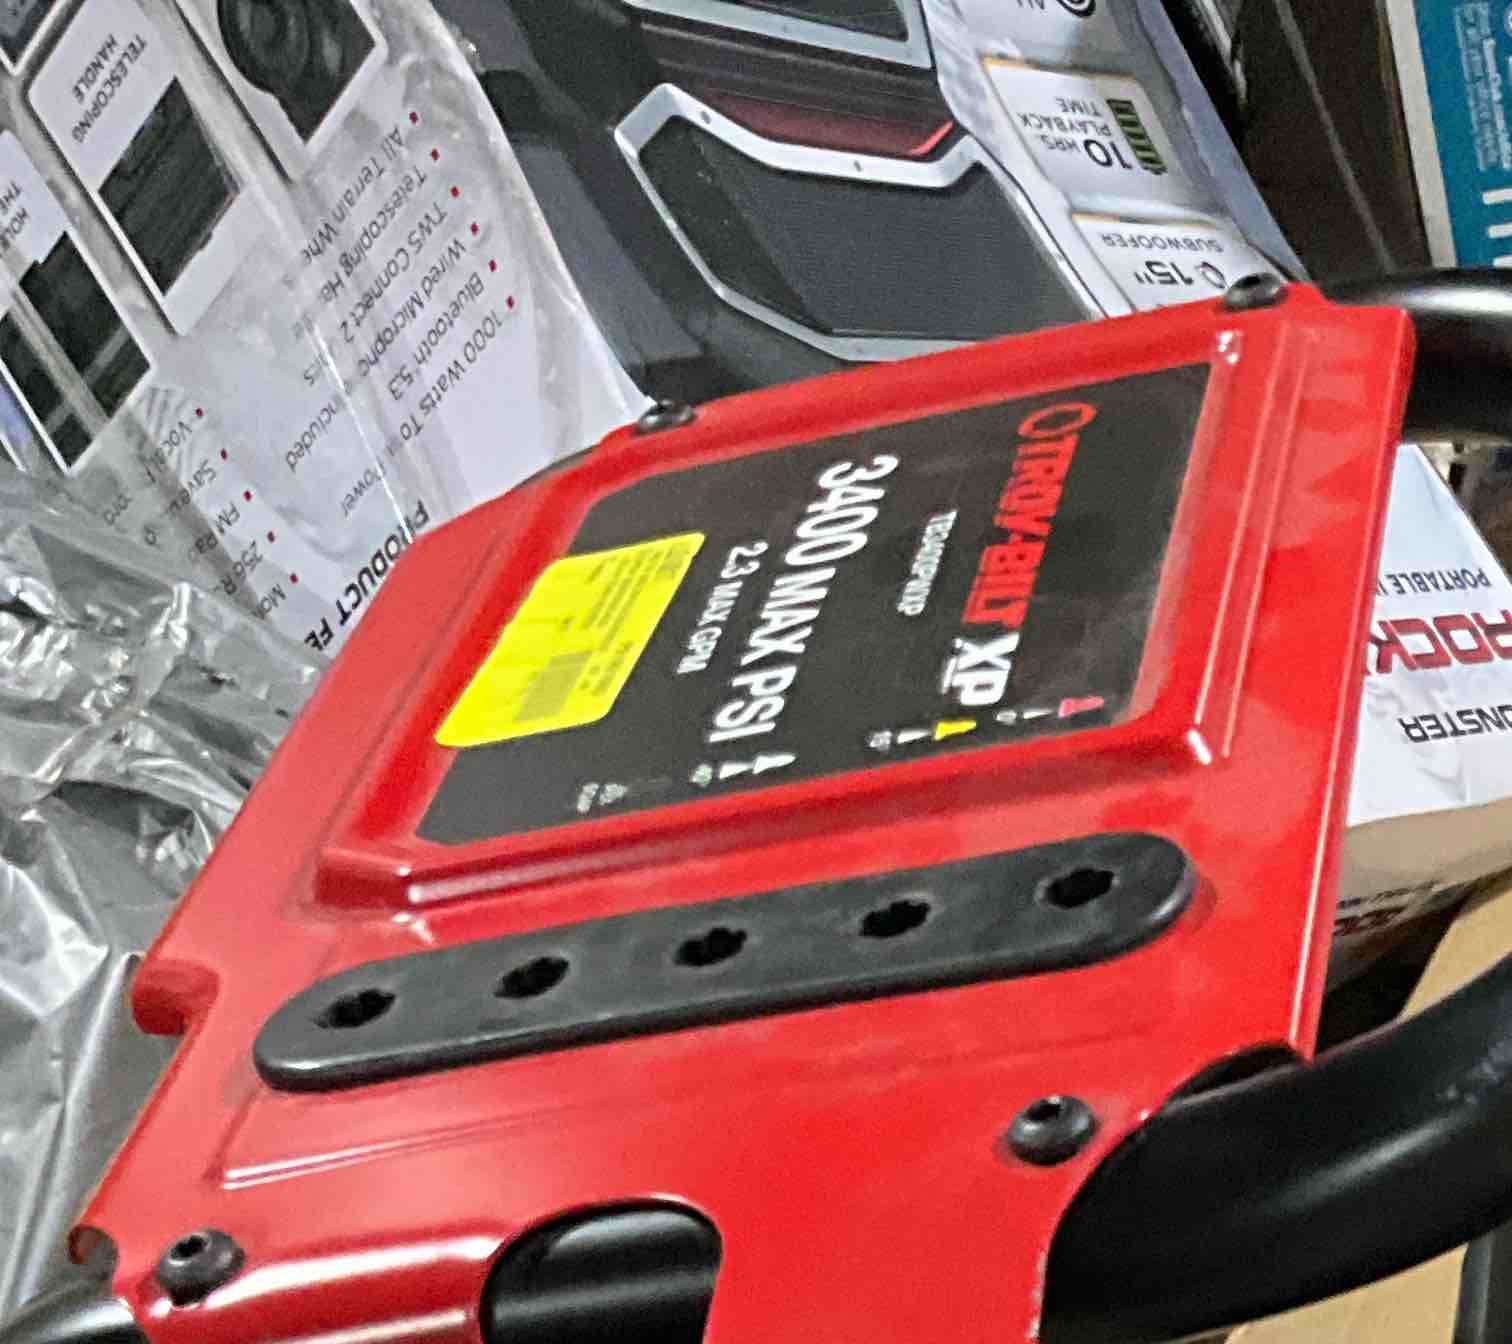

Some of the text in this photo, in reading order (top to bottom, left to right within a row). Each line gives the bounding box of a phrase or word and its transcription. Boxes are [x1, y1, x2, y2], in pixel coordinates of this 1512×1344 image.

[67, 32, 148, 145] TELESCOPING
[68, 32, 120, 104] HANDLE
[1017, 111, 1112, 138] PLAYBACK
[1054, 97, 1104, 117] TIME
[1084, 138, 1133, 171] 10
[330, 154, 386, 225] Terrain
[335, 164, 428, 279] Telescoping
[404, 200, 448, 256] TWS
[1102, 231, 1225, 254] SUBWOOFER
[345, 244, 413, 329] Connect
[415, 235, 468, 298] Wired
[409, 270, 487, 369] Bluetooth
[458, 307, 504, 365] 1000
[416, 357, 469, 418] Watts
[709, 453, 900, 743] 3400 MAX PSI
[950, 433, 1079, 708] TROY-BILT XP
[1387, 567, 1491, 599] PORTABLE
[676, 540, 769, 674] 2.3 MAX GPM
